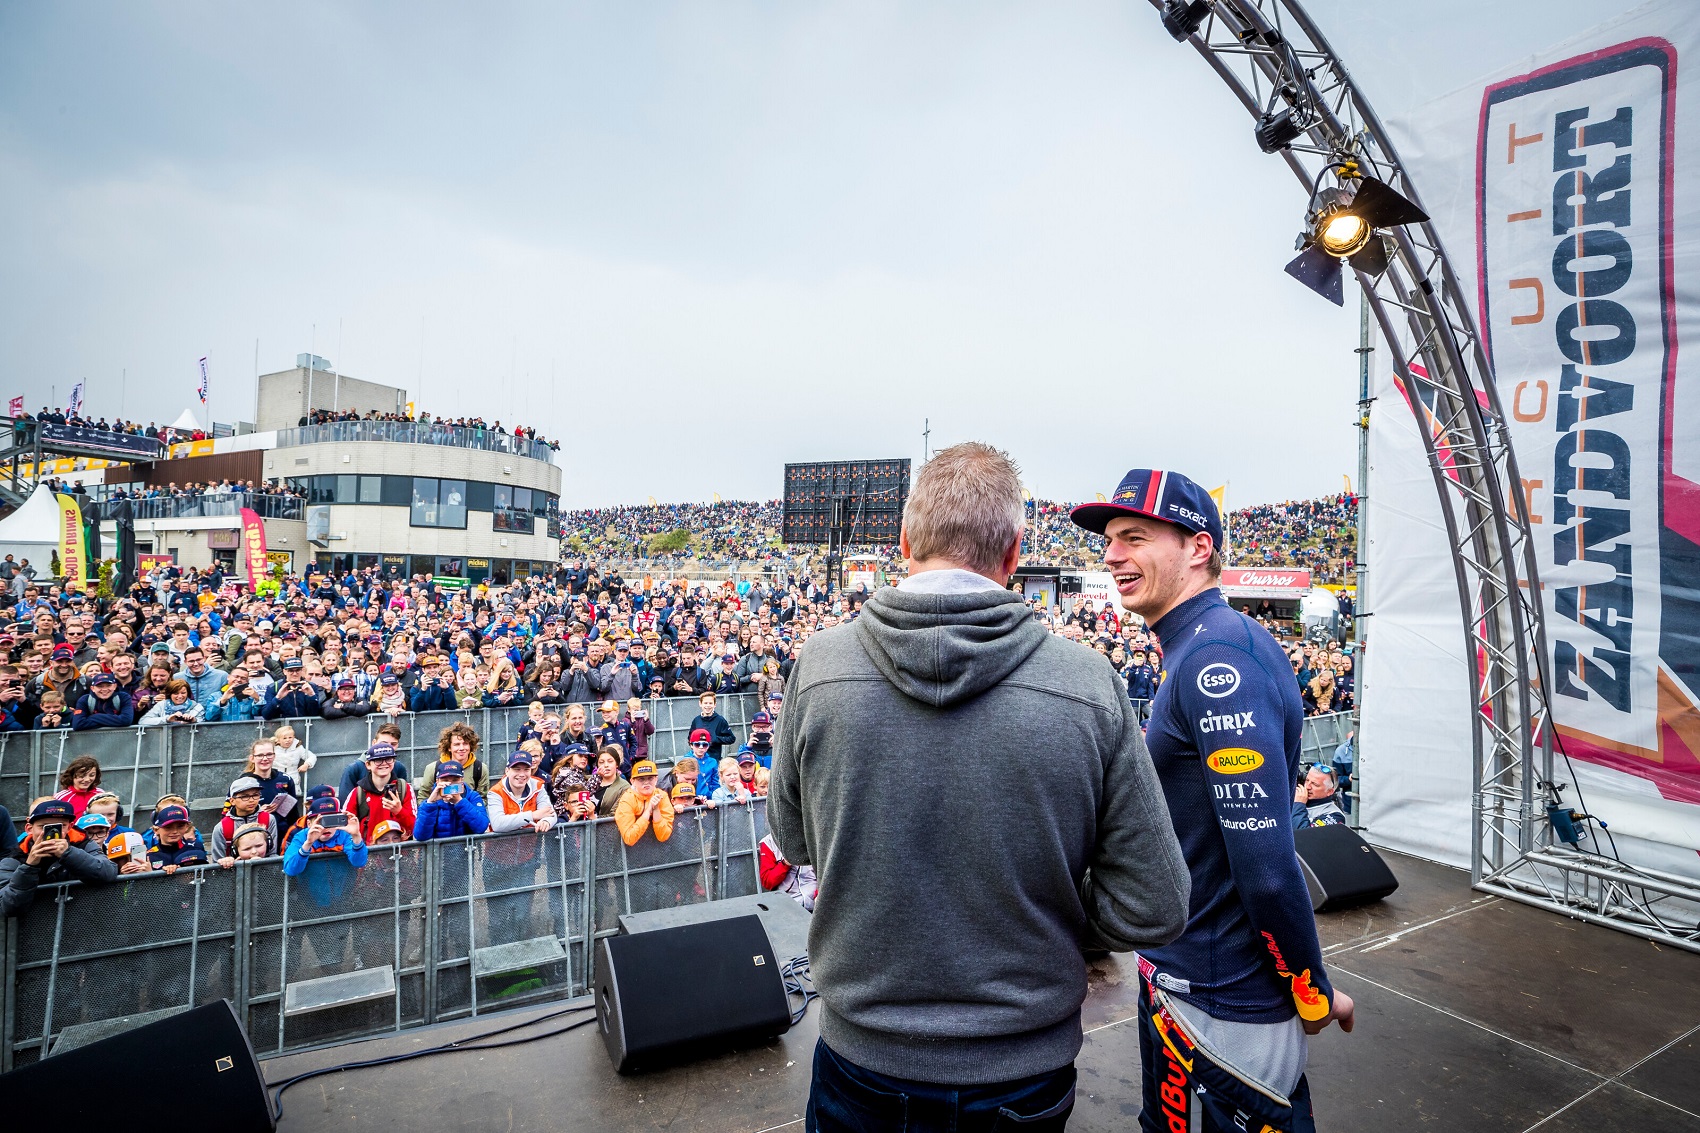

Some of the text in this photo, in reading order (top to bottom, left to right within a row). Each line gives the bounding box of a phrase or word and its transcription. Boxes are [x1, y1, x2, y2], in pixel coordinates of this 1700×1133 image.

[1507, 122, 1549, 690] IRCUIT
[1552, 106, 1636, 714] ZANDVOORT
[1239, 572, 1296, 586] Churros
[1203, 673, 1235, 688] Esso
[1219, 755, 1256, 767] RAUCH
[1213, 782, 1269, 799] DITA
[111, 845, 123, 854] 33
